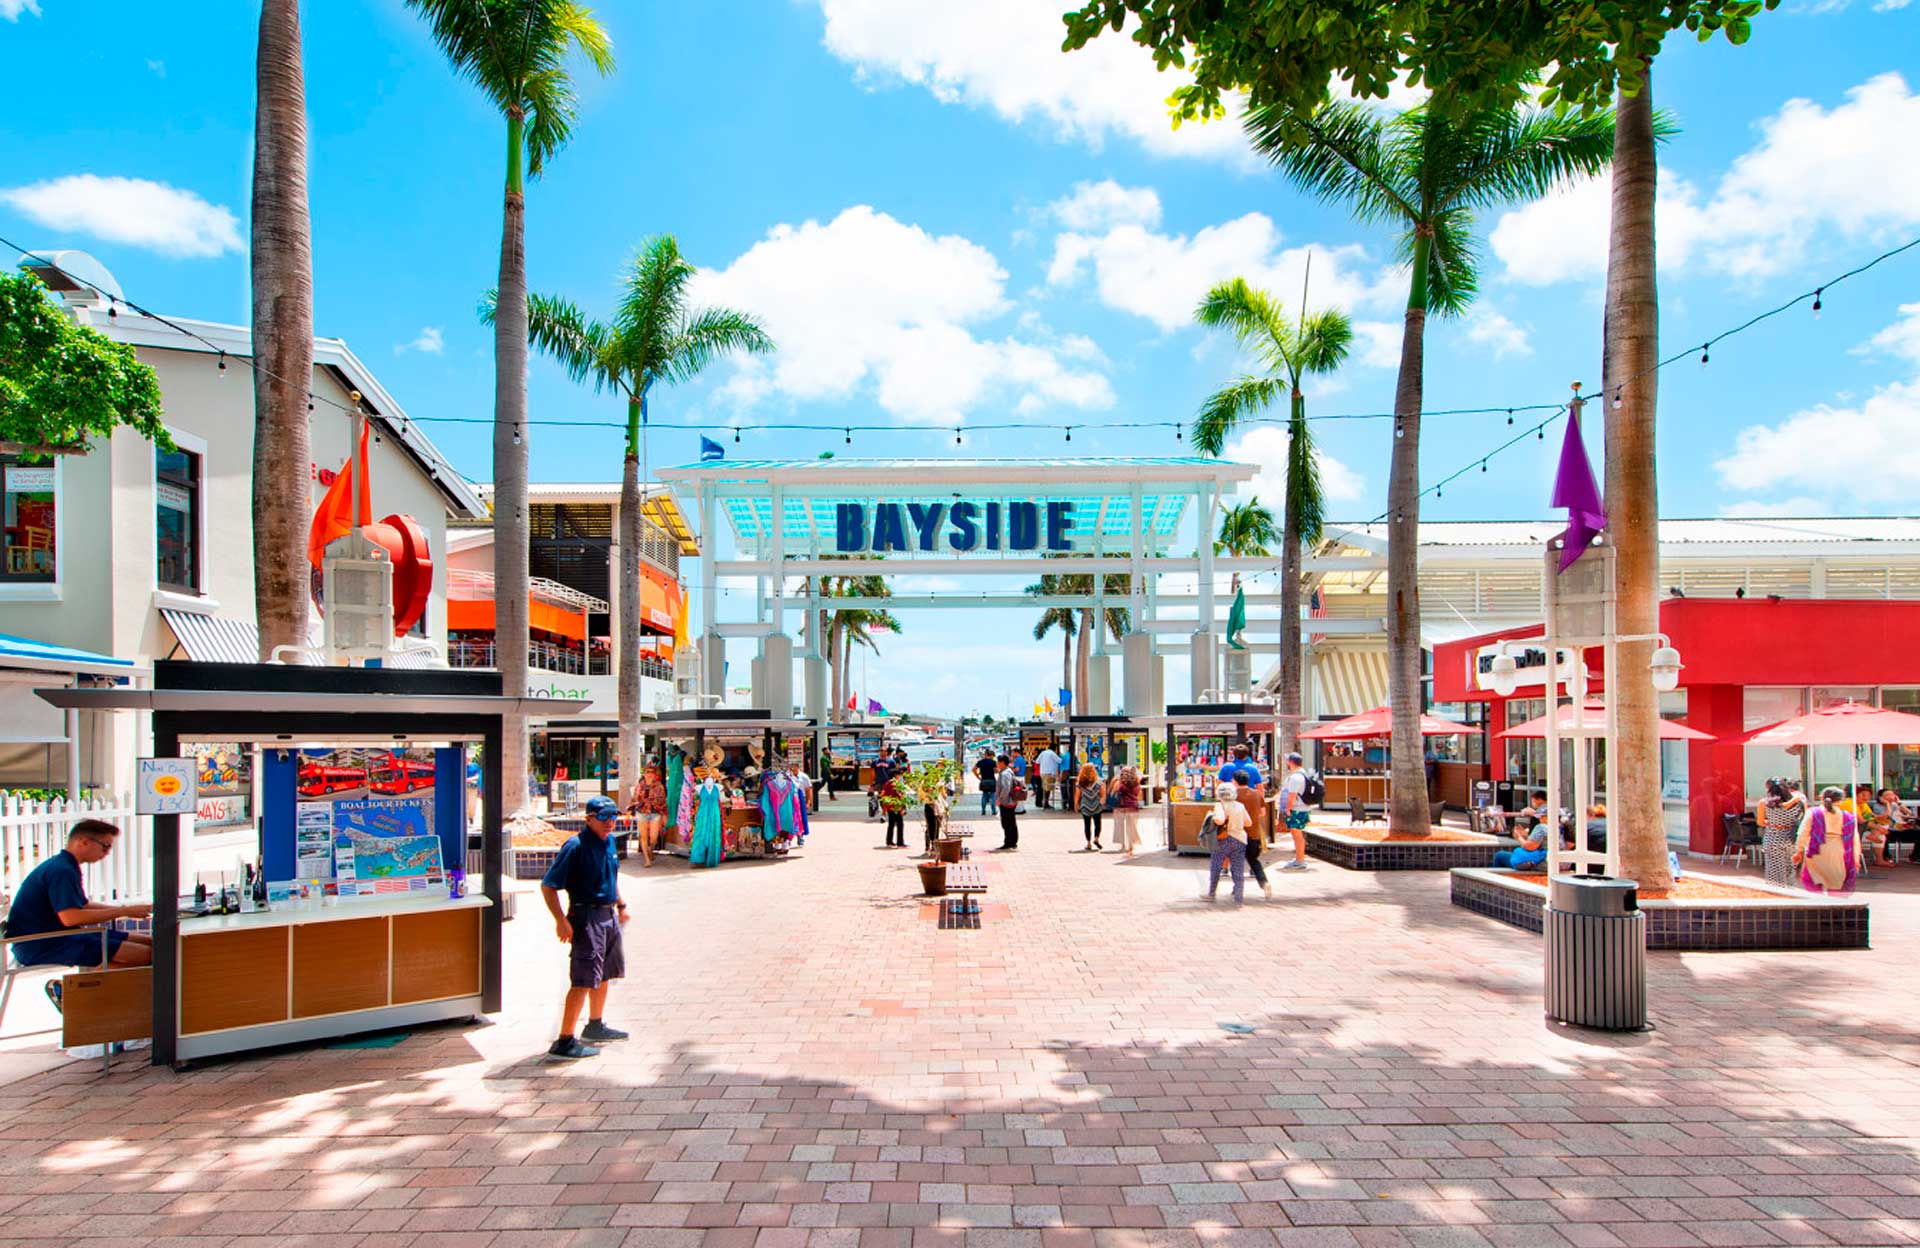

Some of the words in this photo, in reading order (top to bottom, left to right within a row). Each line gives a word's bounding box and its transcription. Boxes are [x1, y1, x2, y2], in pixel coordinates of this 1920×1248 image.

[836, 501, 1073, 551] BAYSIDE
[340, 801, 365, 809] BOAT
[367, 800, 393, 809] TOUR
[395, 799, 432, 808] TICKETS
